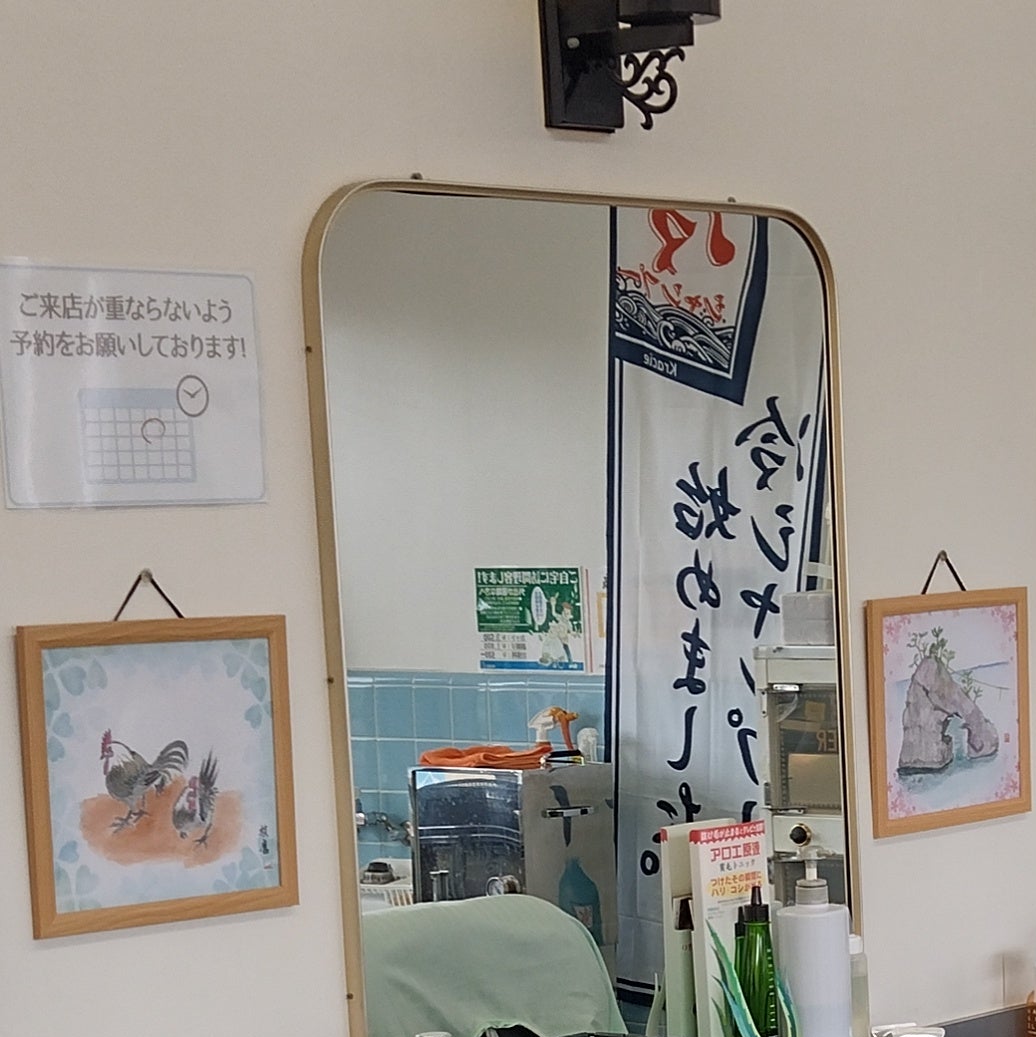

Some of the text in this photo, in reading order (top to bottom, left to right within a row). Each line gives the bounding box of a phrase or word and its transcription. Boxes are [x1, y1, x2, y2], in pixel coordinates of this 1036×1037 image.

[19, 292, 233, 324] ご来店が重ならないよう
[9, 329, 247, 360] 予約をお願いしております!
